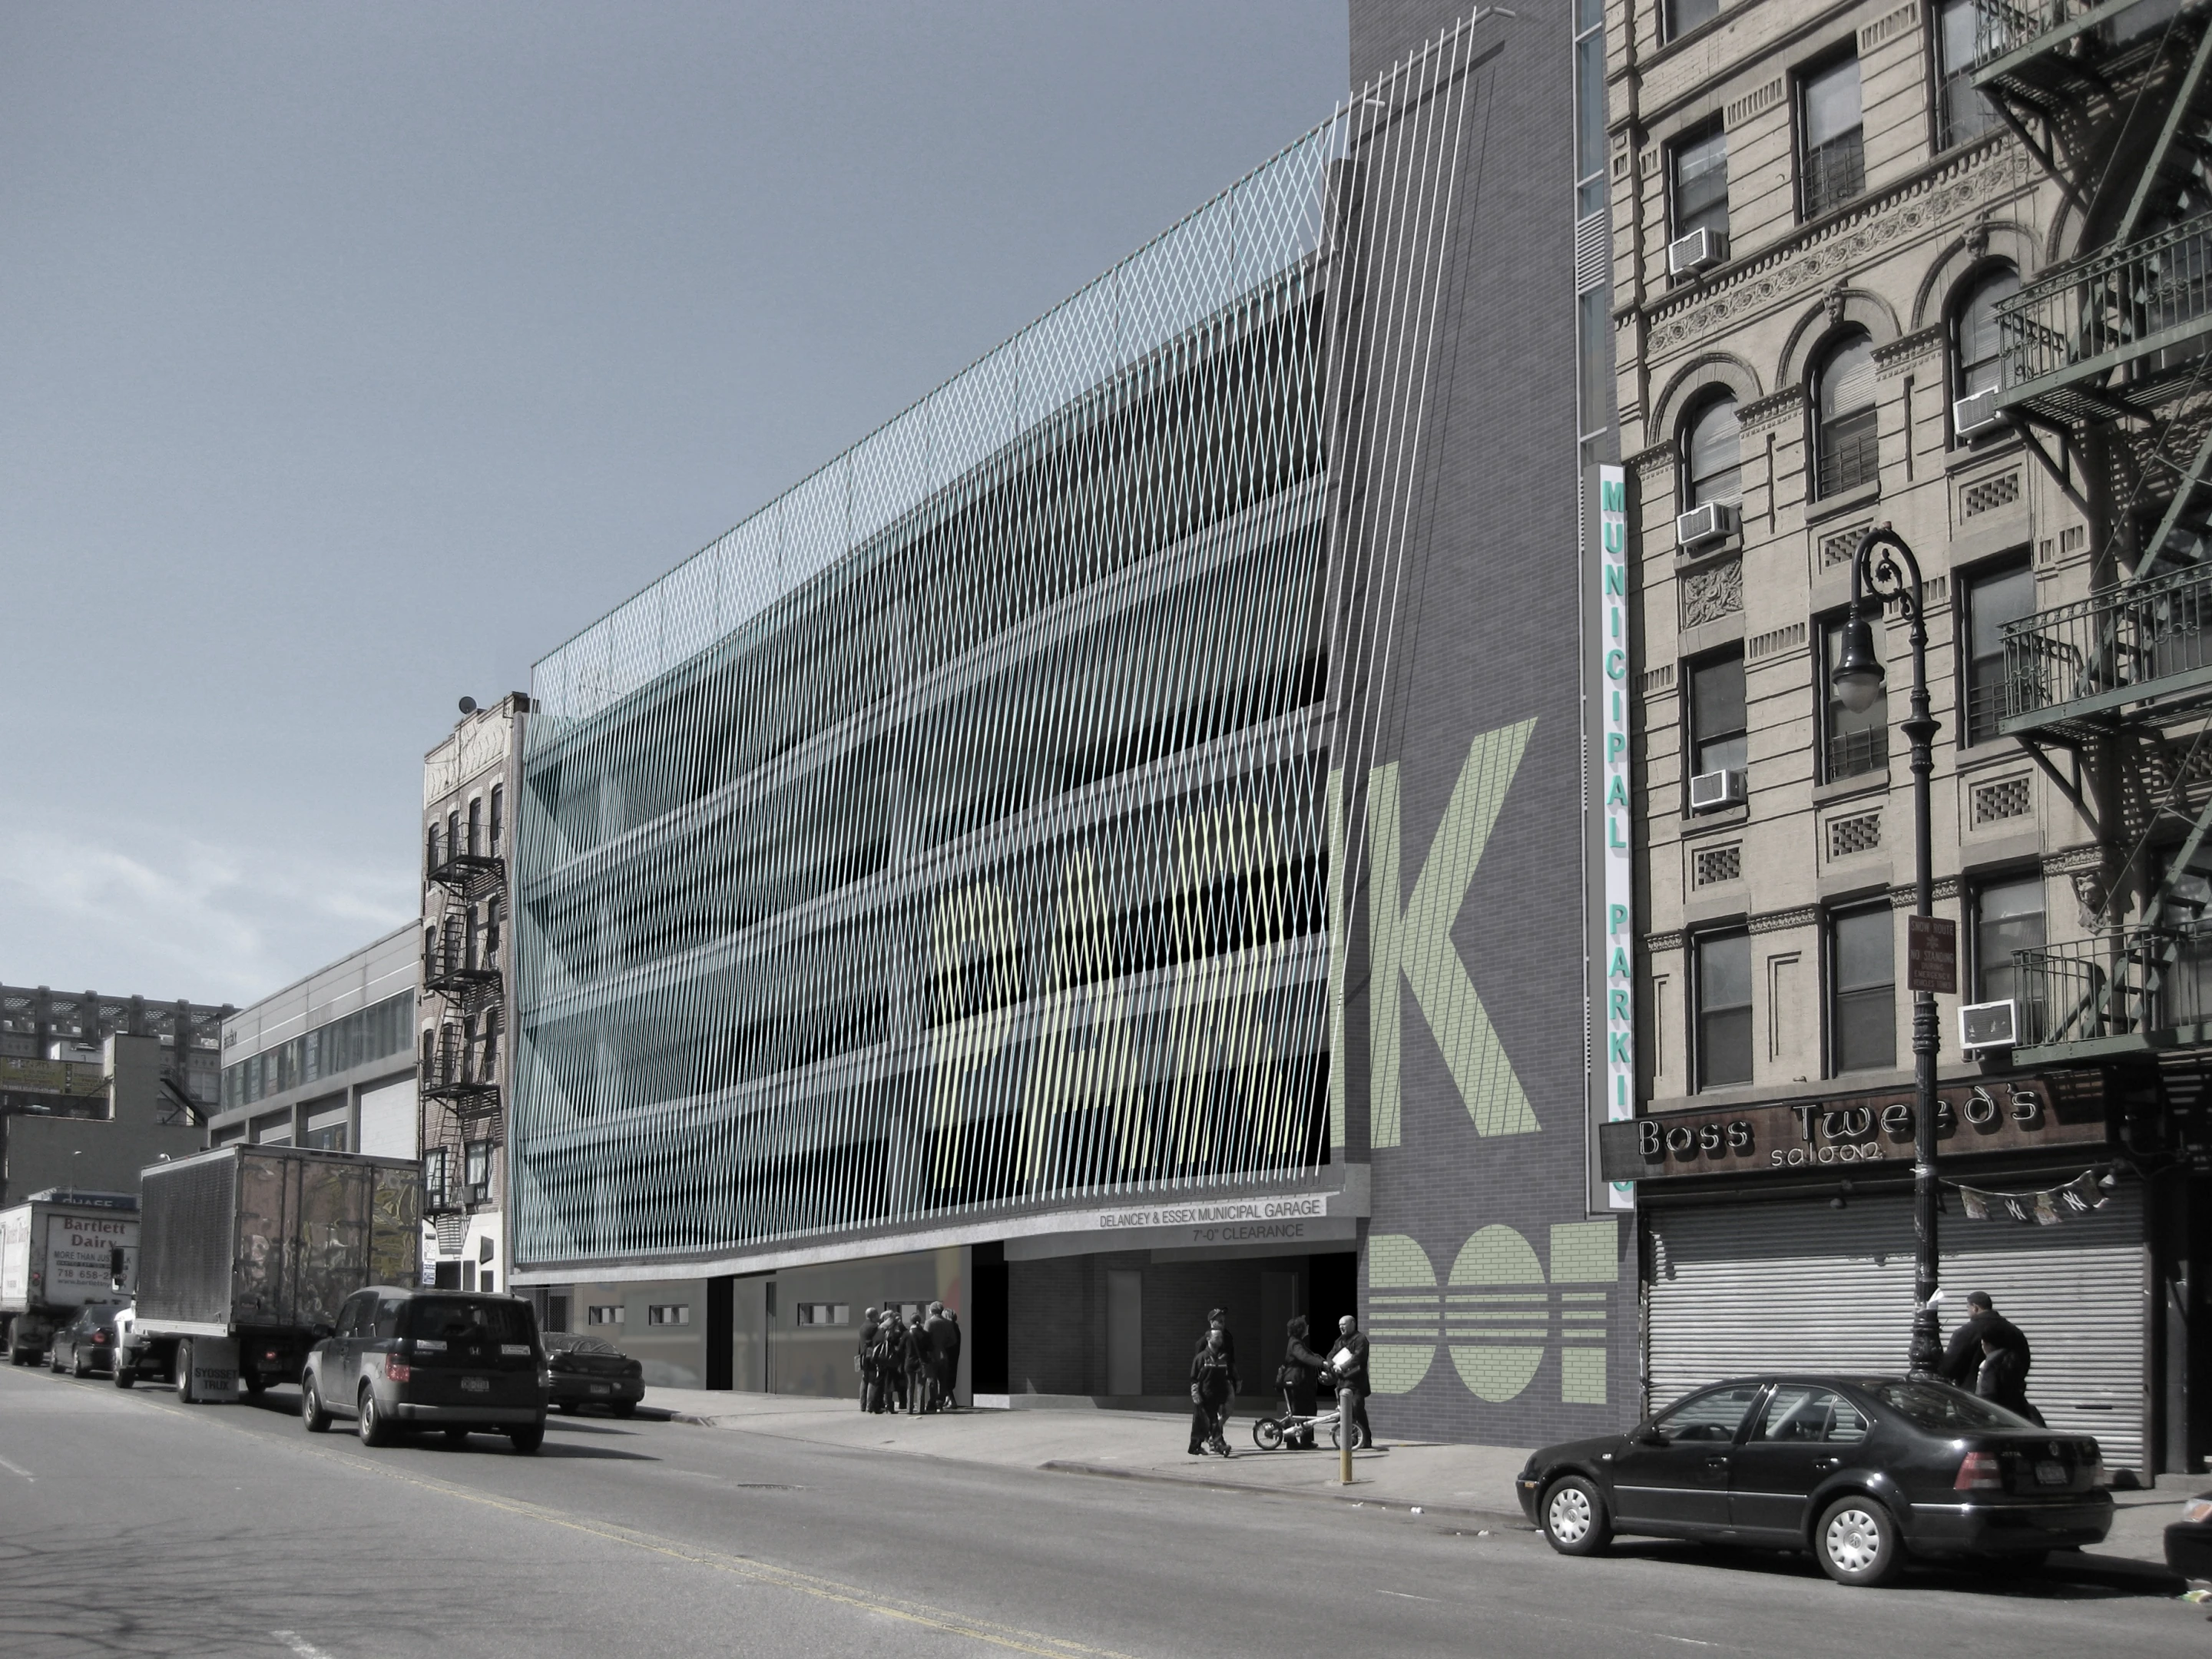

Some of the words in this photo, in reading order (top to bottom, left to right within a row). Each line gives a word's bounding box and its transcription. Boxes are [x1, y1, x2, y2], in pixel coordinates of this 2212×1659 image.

[1602, 480, 1628, 849] MUNICIPAL
[1911, 920, 1930, 933] SNOW
[1933, 923, 1955, 935] ROUTE
[1910, 949, 1920, 960] NO
[1923, 950, 1955, 964] STANDING
[1914, 969, 1951, 980] EMERGENCY
[1607, 903, 1634, 1192] PARKI
[1100, 1212, 1151, 1227] DELANCEY
[1152, 1211, 1160, 1224] &
[1162, 1209, 1195, 1224] ESSEX
[1198, 1204, 1260, 1221] MUNICIPAL
[1264, 1199, 1321, 1217] GARAGE
[64, 1217, 126, 1235] Bartlett
[1222, 1223, 1305, 1241] CLEARANCE
[71, 1233, 117, 1252] Dairy
[55, 1250, 75, 1260] MORE
[77, 1252, 95, 1260] THAN
[97, 1253, 111, 1263] JUS
[58, 1268, 74, 1277] 718
[194, 1367, 238, 1380] SYOSSET
[204, 1379, 230, 1390] TRUX
